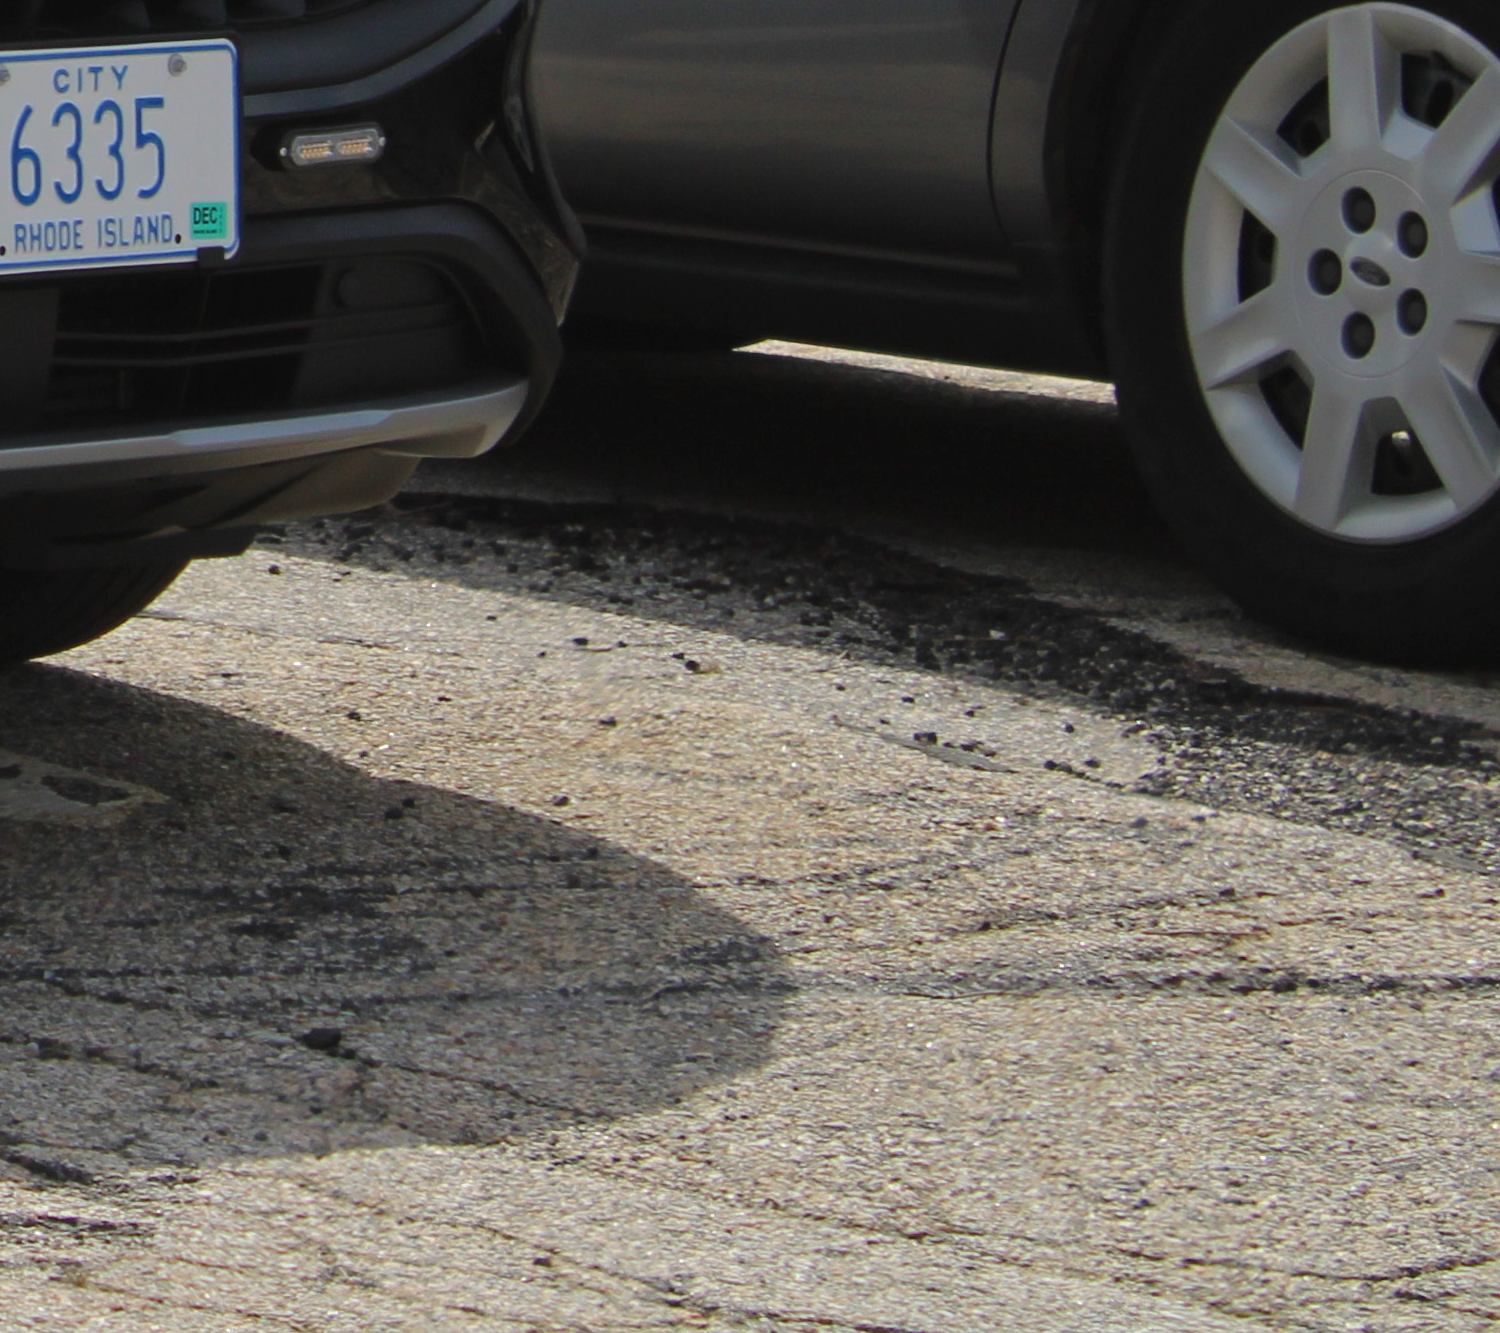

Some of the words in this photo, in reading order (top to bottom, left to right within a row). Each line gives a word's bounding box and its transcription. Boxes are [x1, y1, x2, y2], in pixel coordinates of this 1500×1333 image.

[53, 65, 128, 93] CITY
[10, 97, 165, 206] 6335
[193, 206, 218, 225] DEC
[13, 219, 84, 253] RHODE
[97, 214, 173, 247] ISLAND
